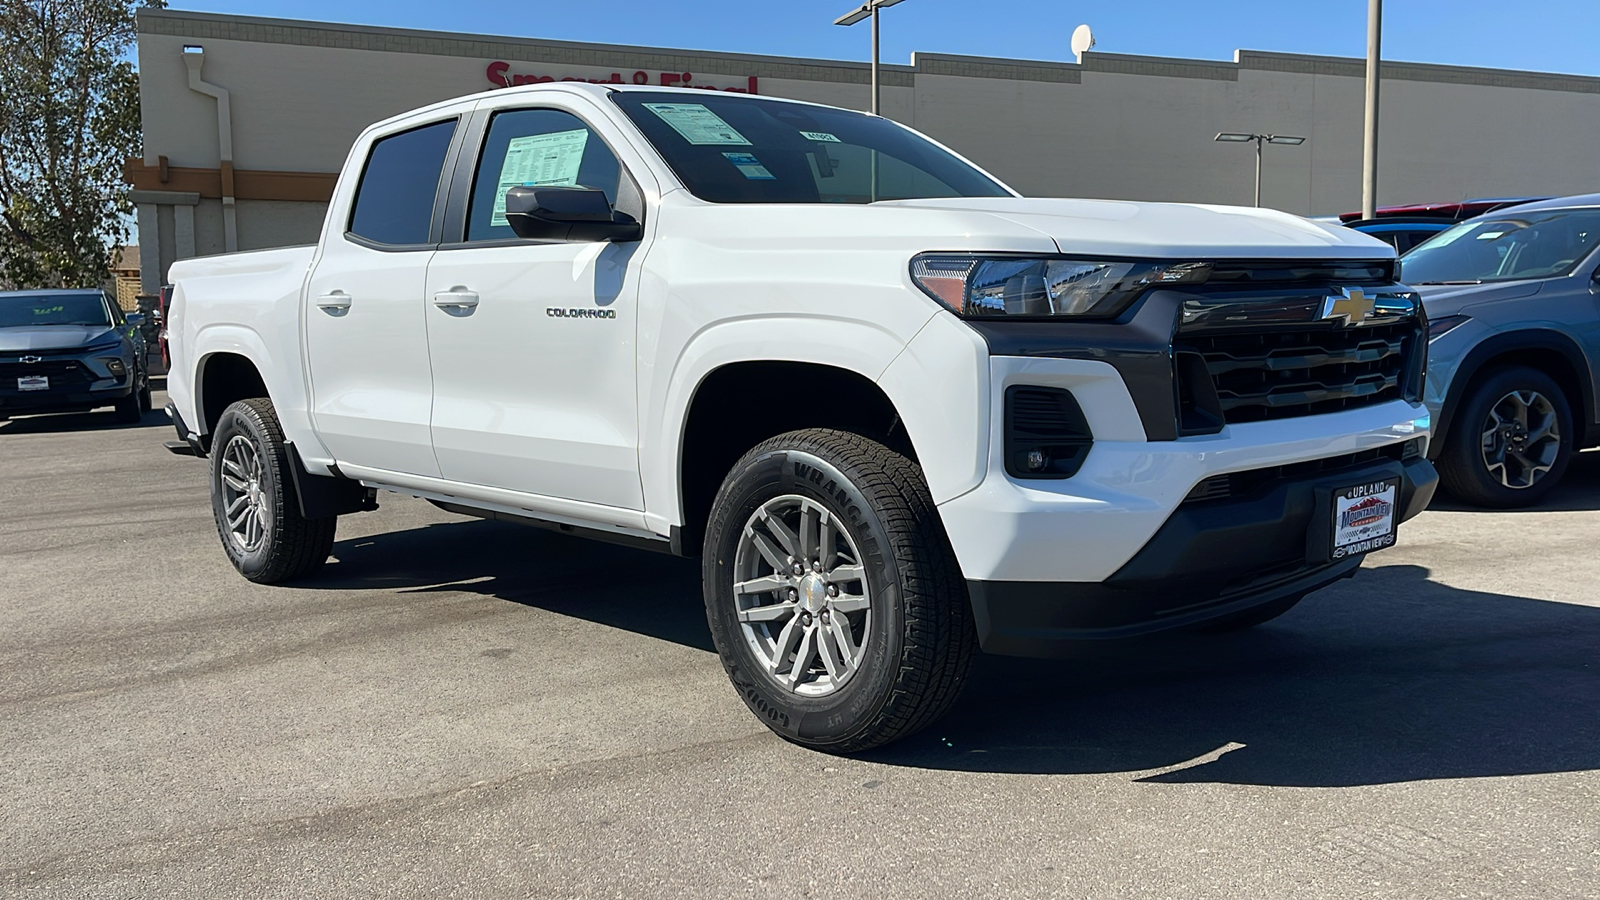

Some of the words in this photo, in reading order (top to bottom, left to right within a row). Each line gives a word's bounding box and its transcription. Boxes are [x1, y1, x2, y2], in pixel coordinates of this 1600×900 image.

[546, 308, 617, 319] COLORADO
[1353, 482, 1384, 497] UPLAND
[794, 461, 886, 574] WRANGLER
